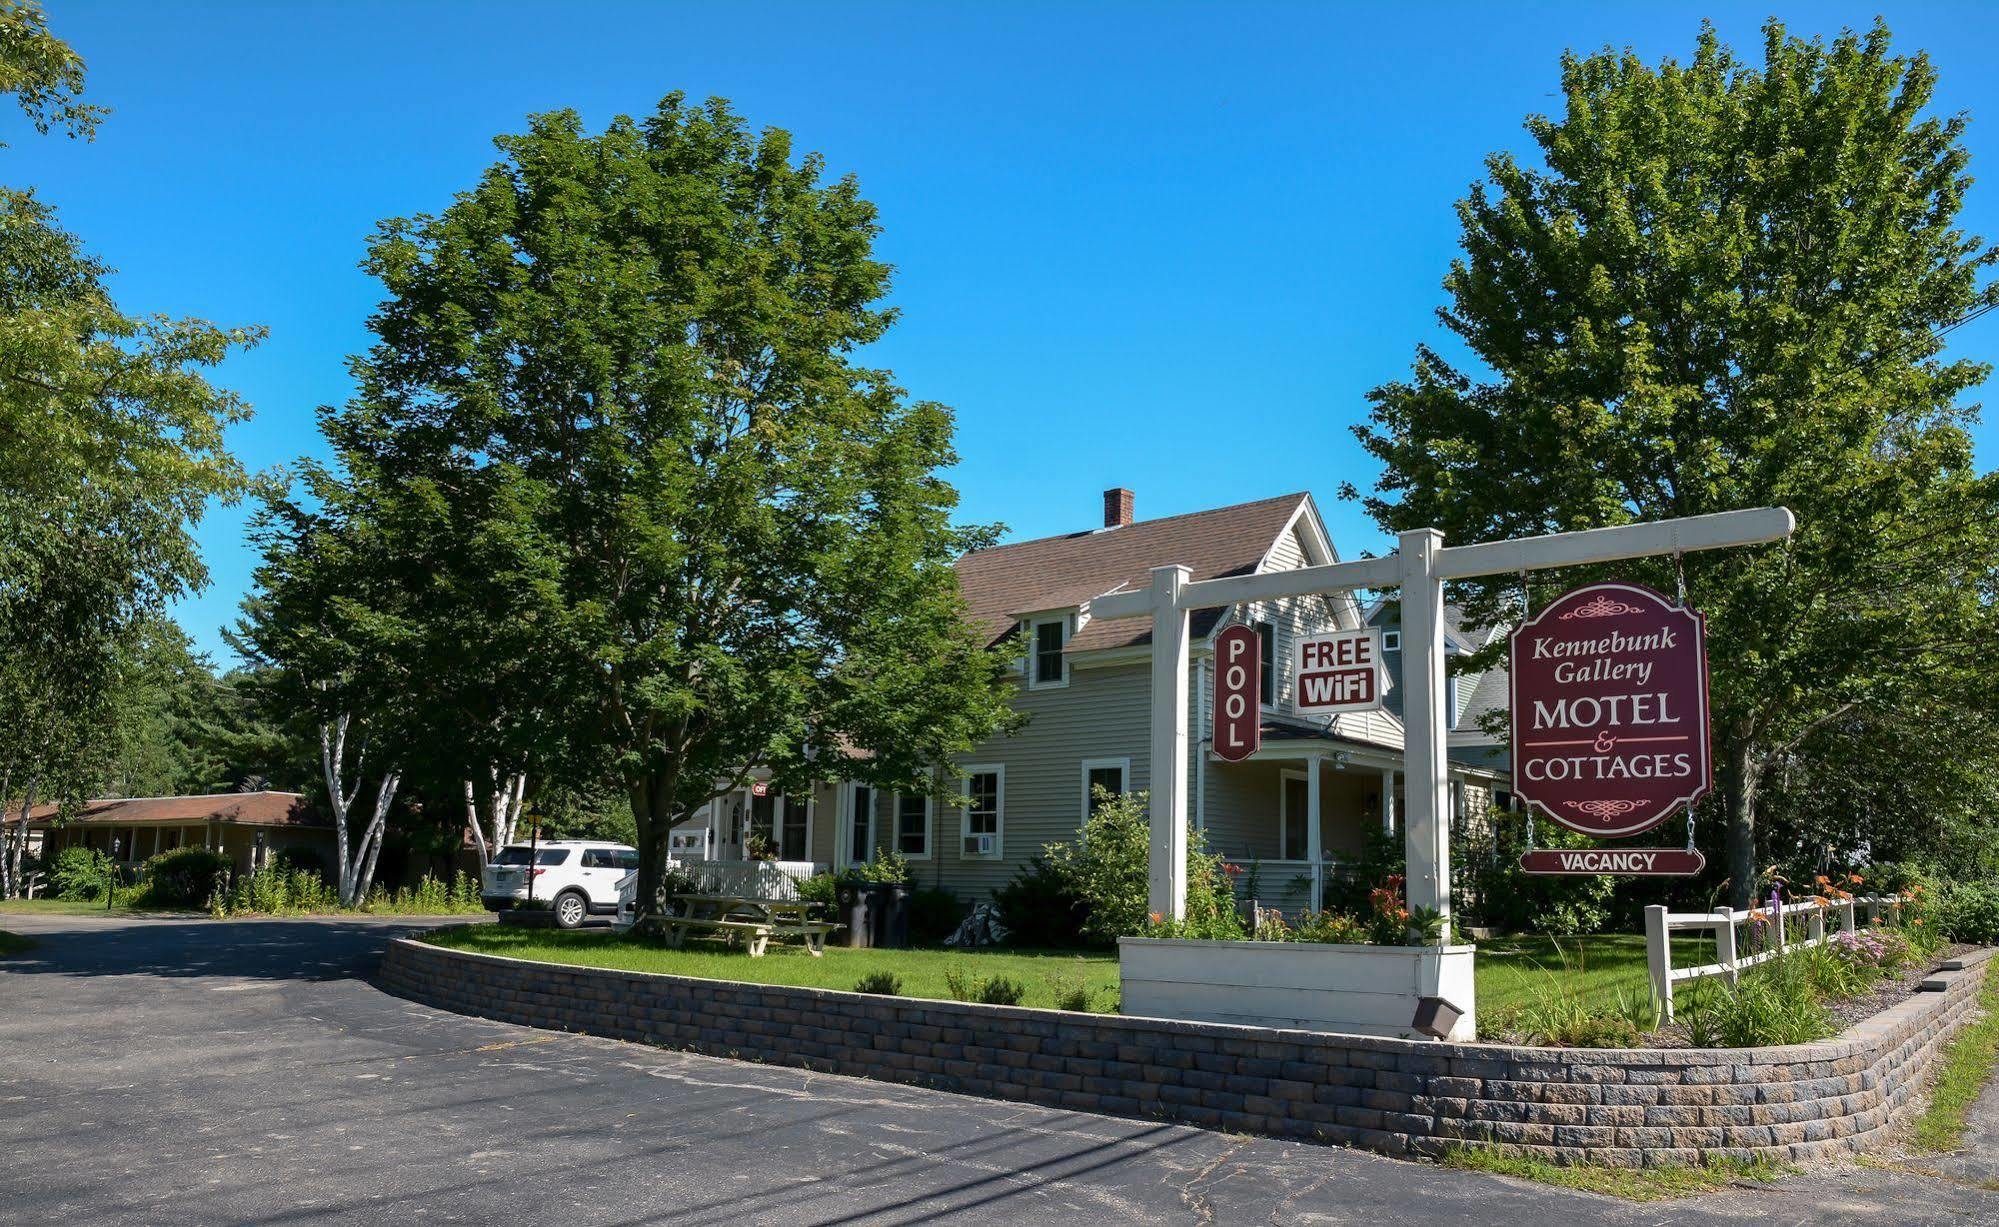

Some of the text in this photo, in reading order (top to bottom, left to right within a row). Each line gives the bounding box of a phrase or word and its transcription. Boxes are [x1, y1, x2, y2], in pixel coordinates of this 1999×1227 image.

[1302, 637, 1370, 669] FREE
[1532, 627, 1677, 660] Kennebunk
[1554, 658, 1653, 685] Gallery
[1226, 639, 1246, 747] POOL
[1304, 672, 1367, 703] WiFi
[1533, 693, 1680, 729] MOTEL
[1593, 731, 1617, 752] &
[1524, 753, 1691, 781] COTTAGES
[1560, 853, 1657, 871] VACANCY
